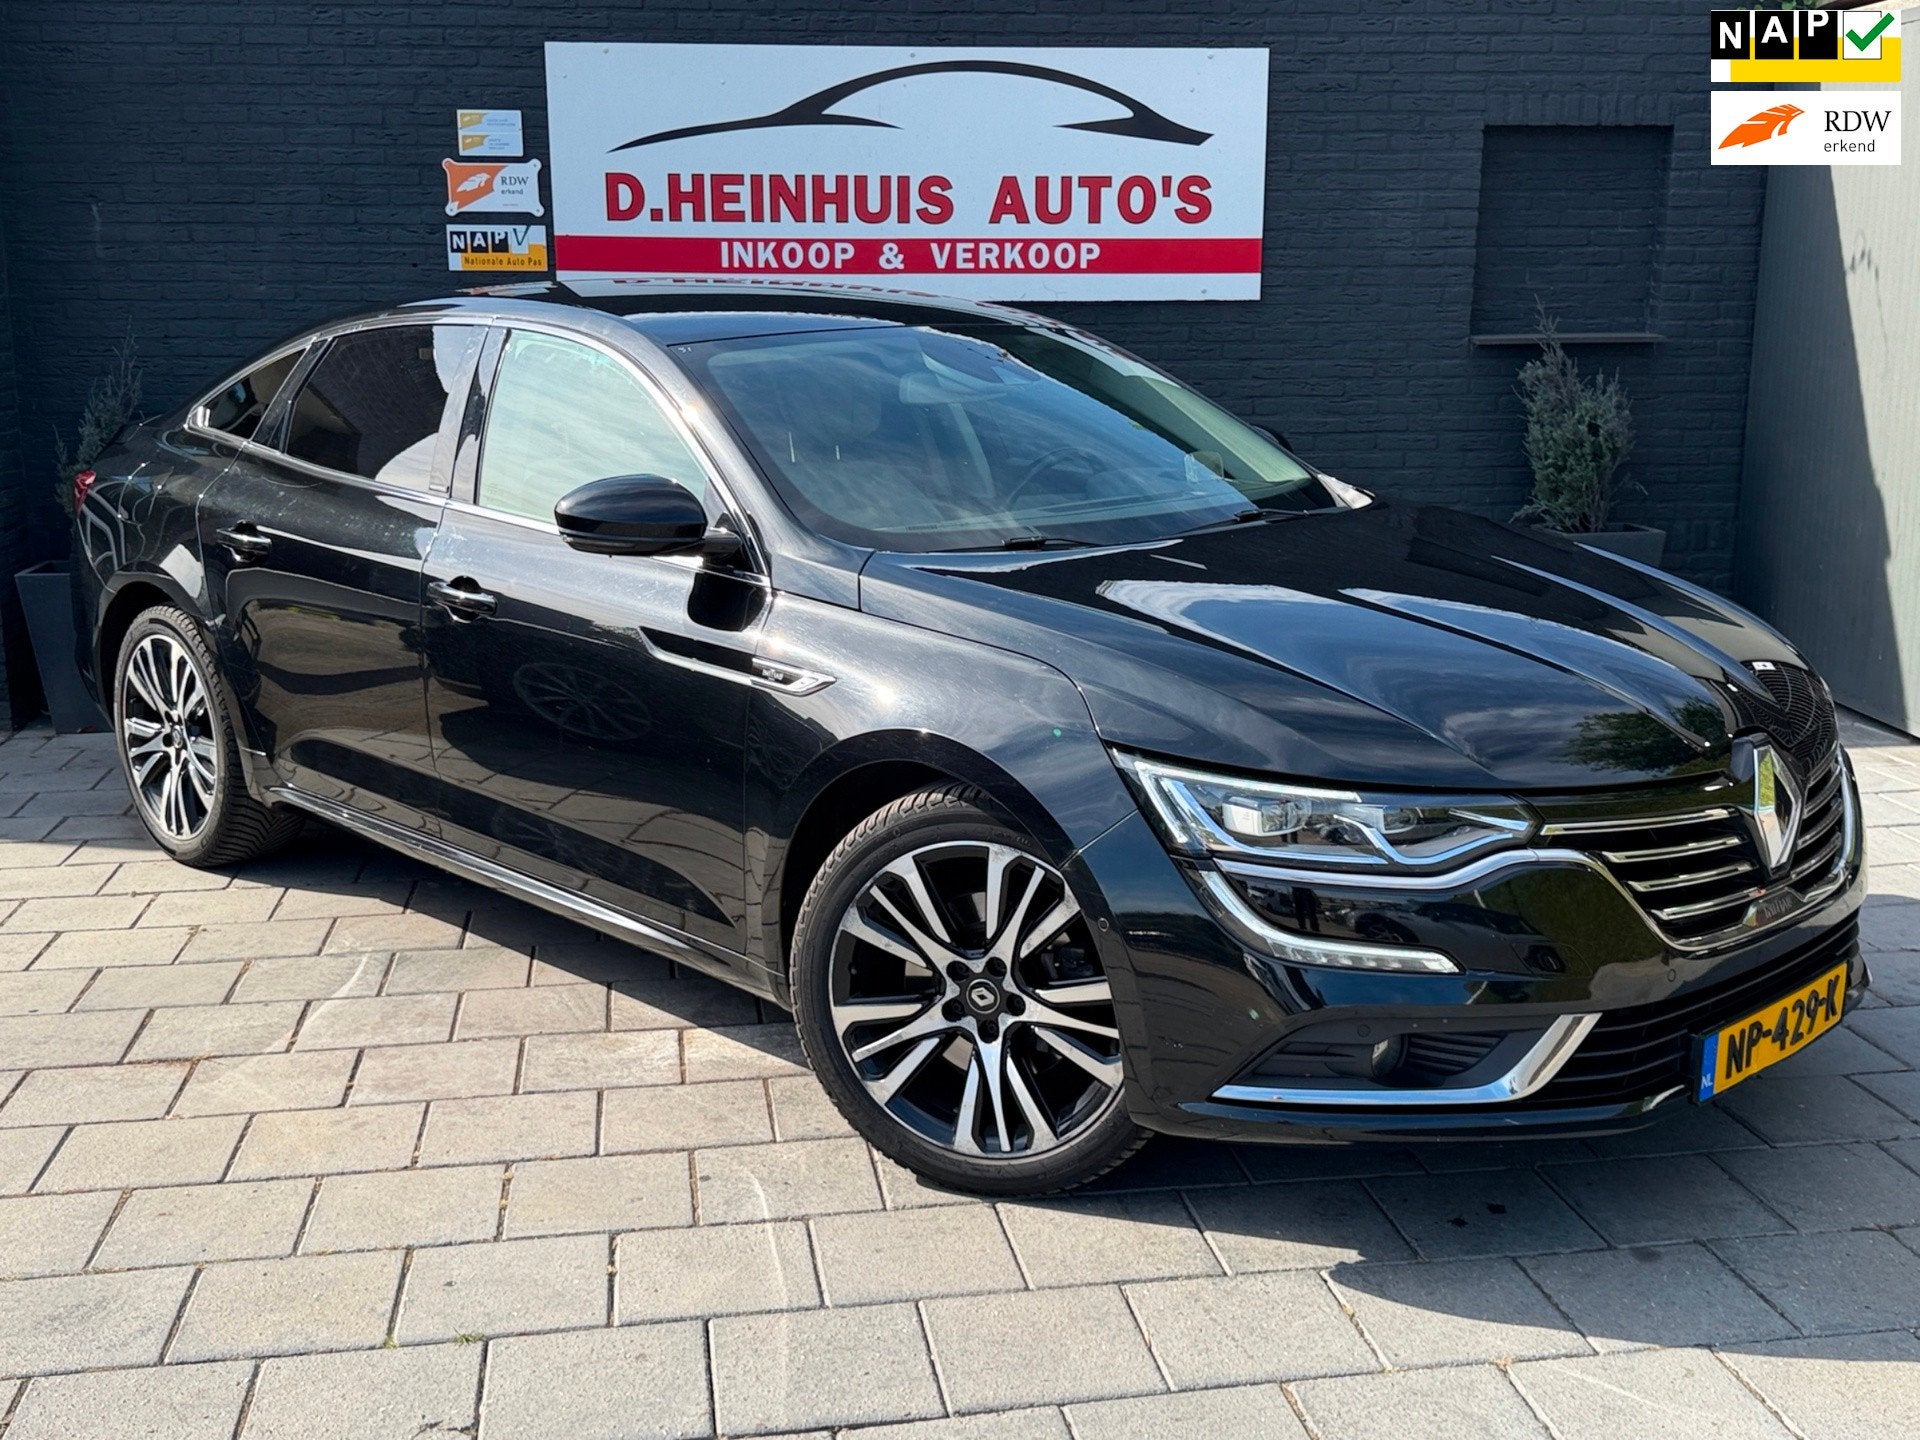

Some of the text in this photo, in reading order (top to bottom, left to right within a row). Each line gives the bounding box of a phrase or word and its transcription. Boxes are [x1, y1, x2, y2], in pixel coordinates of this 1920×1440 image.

[500, 176, 529, 186] RDW
[605, 172, 1213, 224] D.HEINHUIS AUTO'S
[464, 256, 542, 266] Nationale Auto Pas
[720, 241, 1101, 270] INKOOP & VERKOOP
[1725, 974, 1840, 1080] NP-429-K
